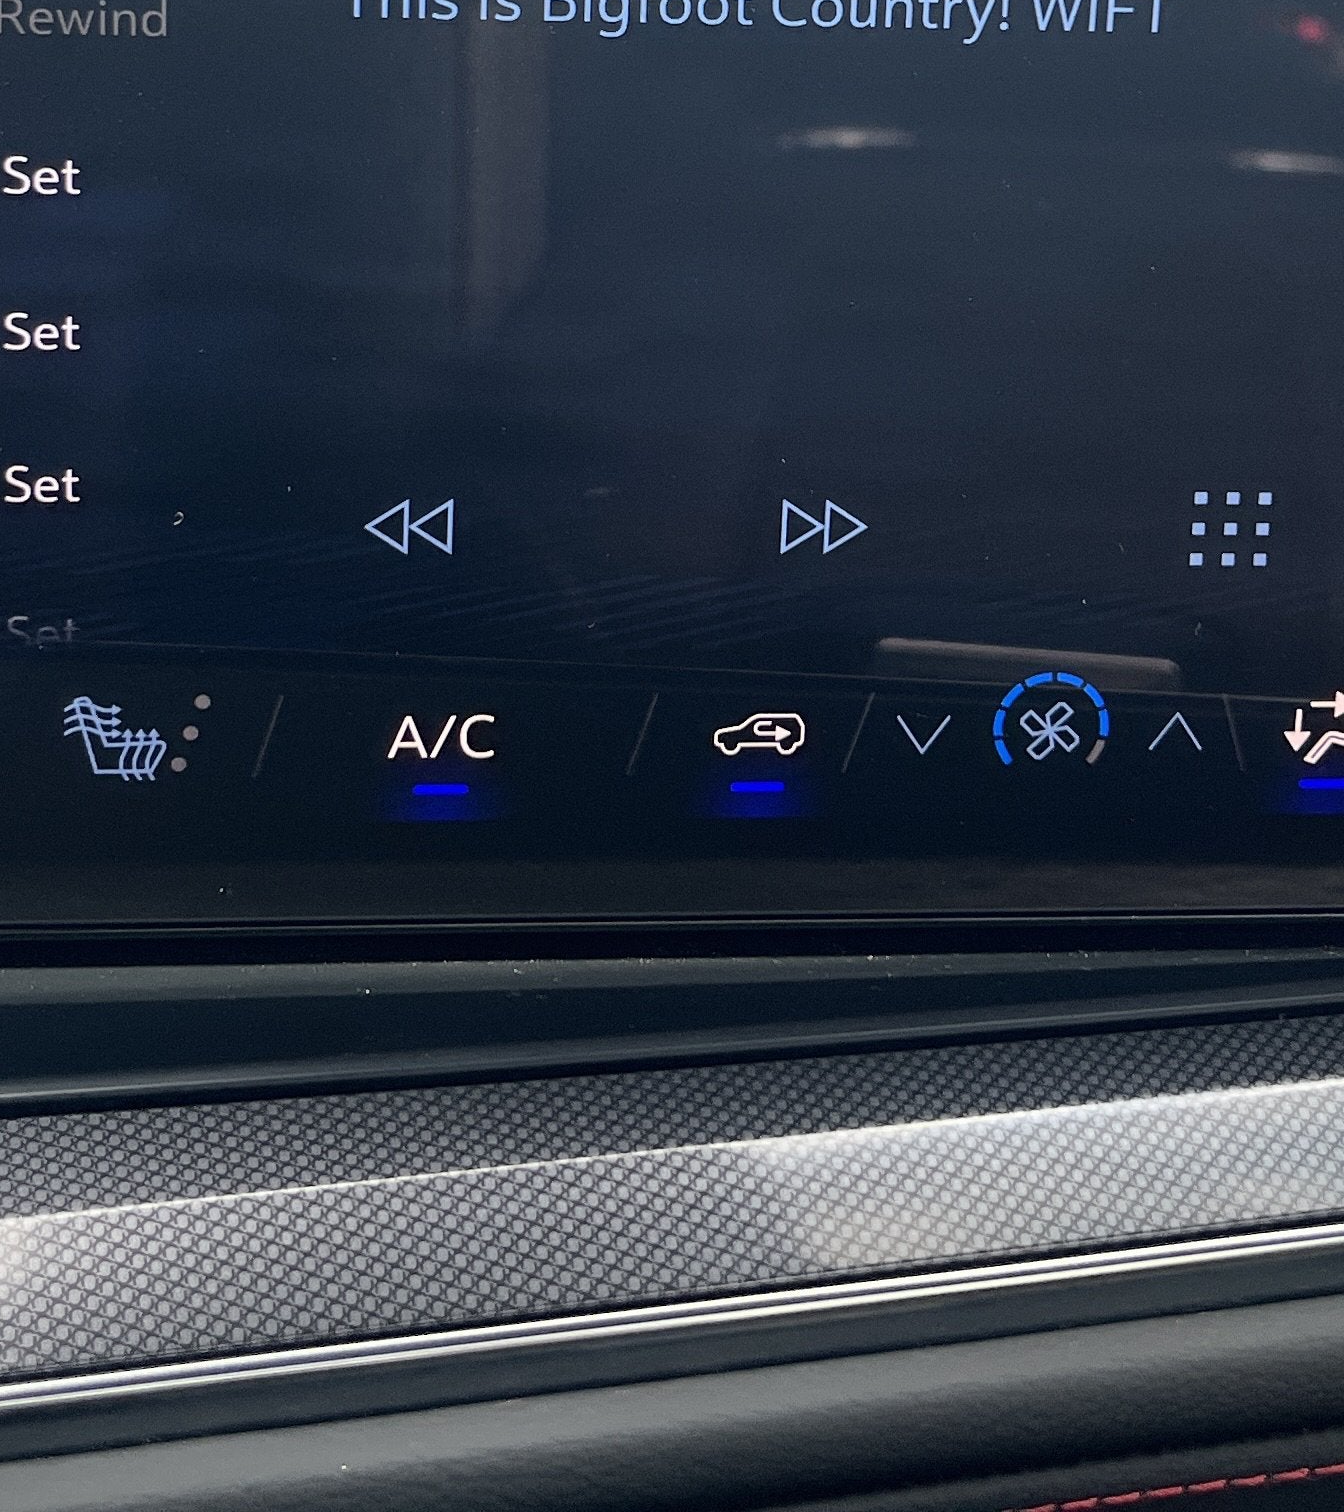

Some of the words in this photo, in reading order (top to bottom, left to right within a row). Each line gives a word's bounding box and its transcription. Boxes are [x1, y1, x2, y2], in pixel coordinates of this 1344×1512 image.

[2, 155, 82, 196] Set
[2, 312, 82, 352] Set
[3, 465, 82, 504] Set
[6, 616, 81, 646] Set
[386, 714, 496, 763] A/C
